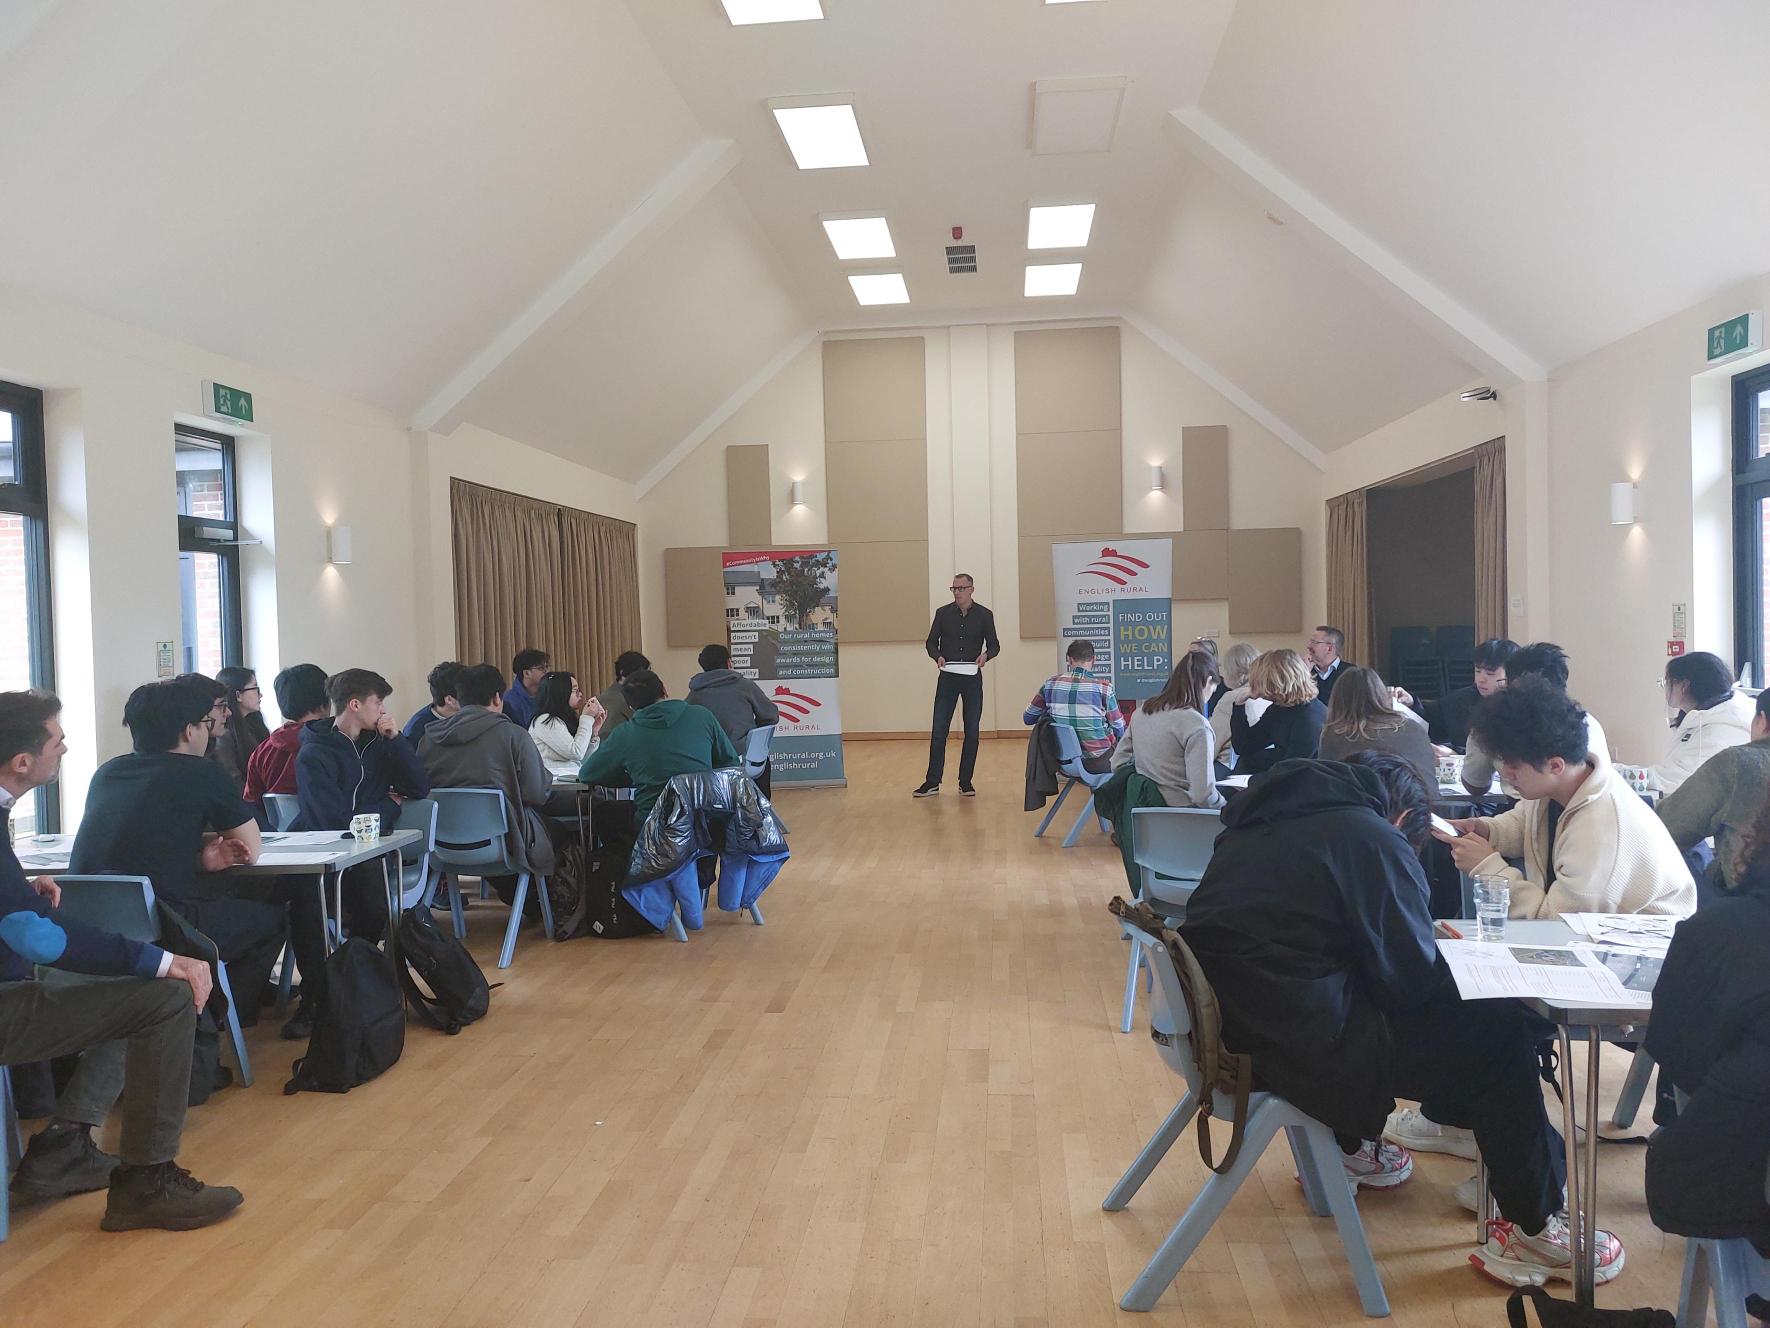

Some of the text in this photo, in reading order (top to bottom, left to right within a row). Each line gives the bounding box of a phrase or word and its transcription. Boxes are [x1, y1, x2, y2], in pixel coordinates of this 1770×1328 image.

[1078, 587, 1116, 595] ENGLISH
[1079, 603, 1109, 612] Working
[1119, 612, 1168, 622] FIND OUT
[732, 620, 768, 628] Affordable
[732, 632, 757, 640] doesn't
[793, 631, 810, 639] rural
[1064, 628, 1109, 636] communities
[1120, 625, 1168, 640] HOW
[780, 643, 820, 651] consistently
[1119, 642, 1168, 653] WE CAN
[733, 658, 749, 666] poor
[812, 655, 834, 663] design
[1120, 656, 1168, 670] HELP:
[792, 667, 834, 675] construction
